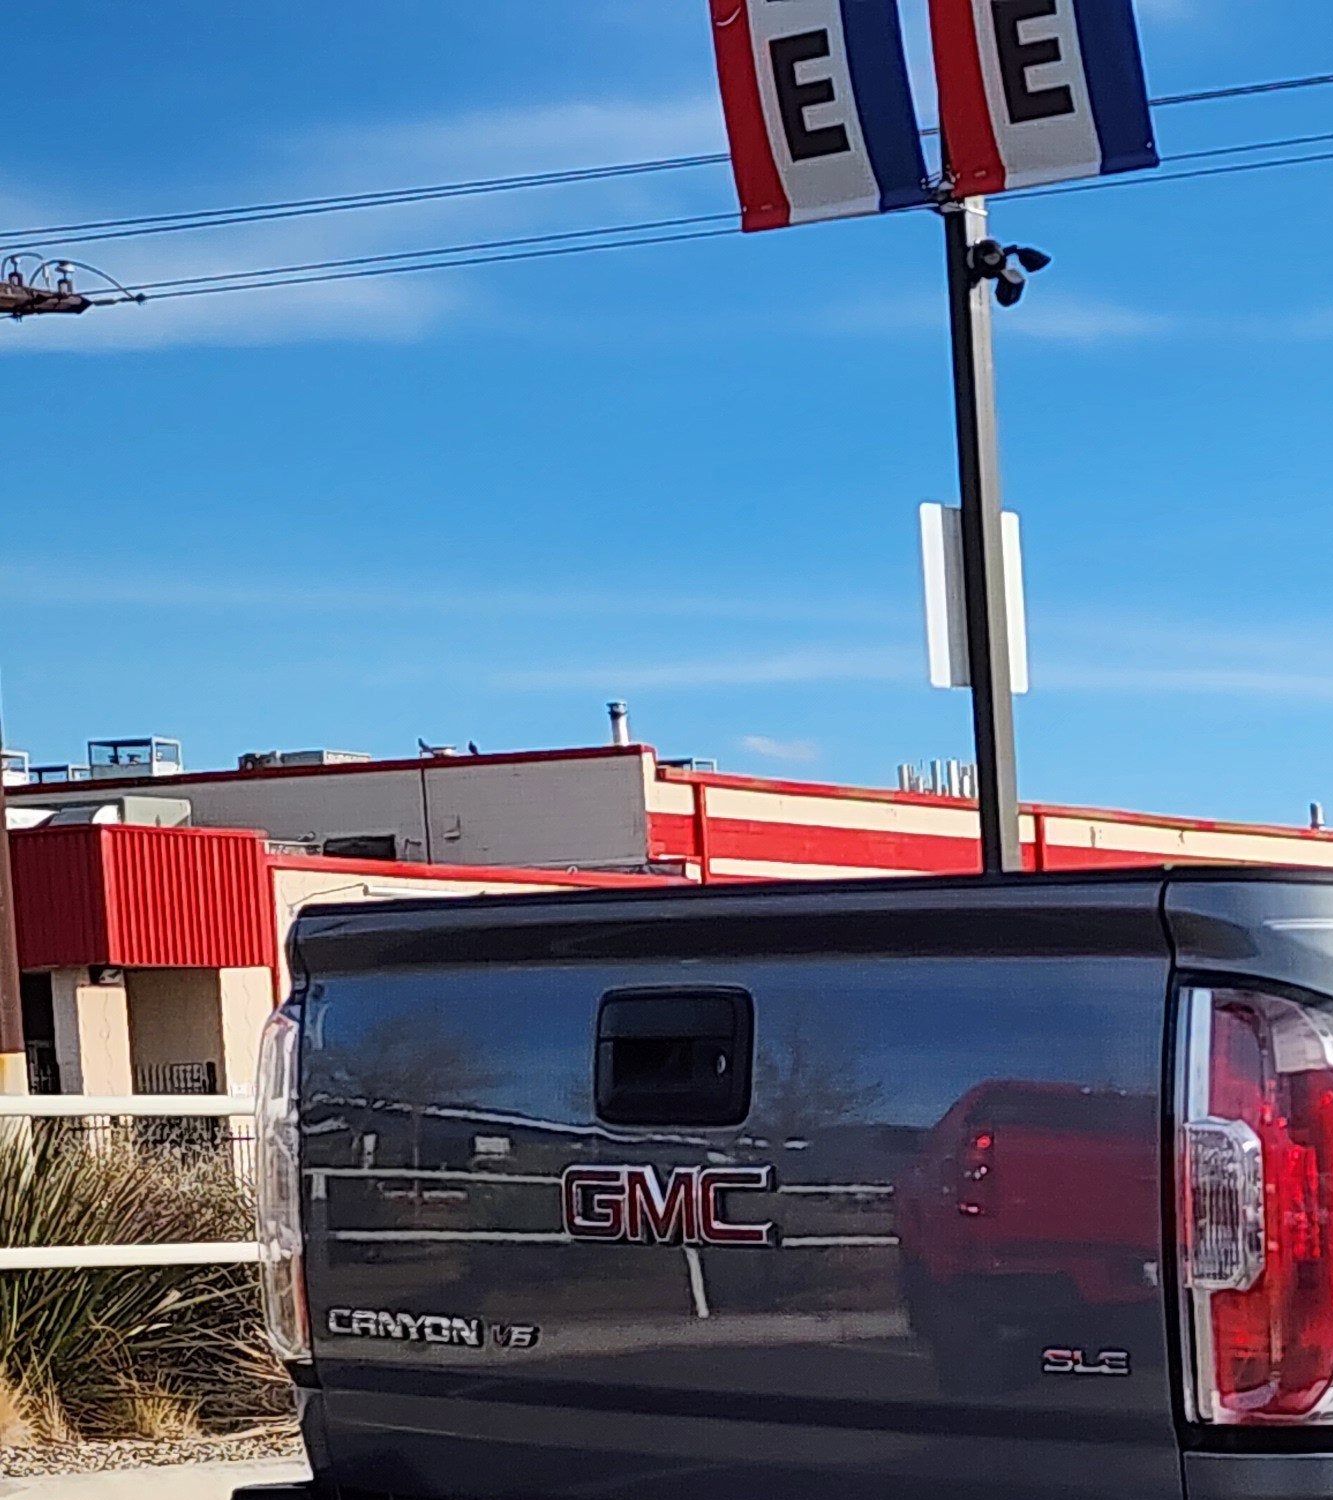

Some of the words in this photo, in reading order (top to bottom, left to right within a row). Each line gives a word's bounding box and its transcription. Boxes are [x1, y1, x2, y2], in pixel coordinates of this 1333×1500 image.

[561, 1164, 774, 1245] GMC
[327, 1307, 481, 1346] CANYON
[490, 1324, 535, 1348] V6
[1043, 1348, 1129, 1374] SLE
